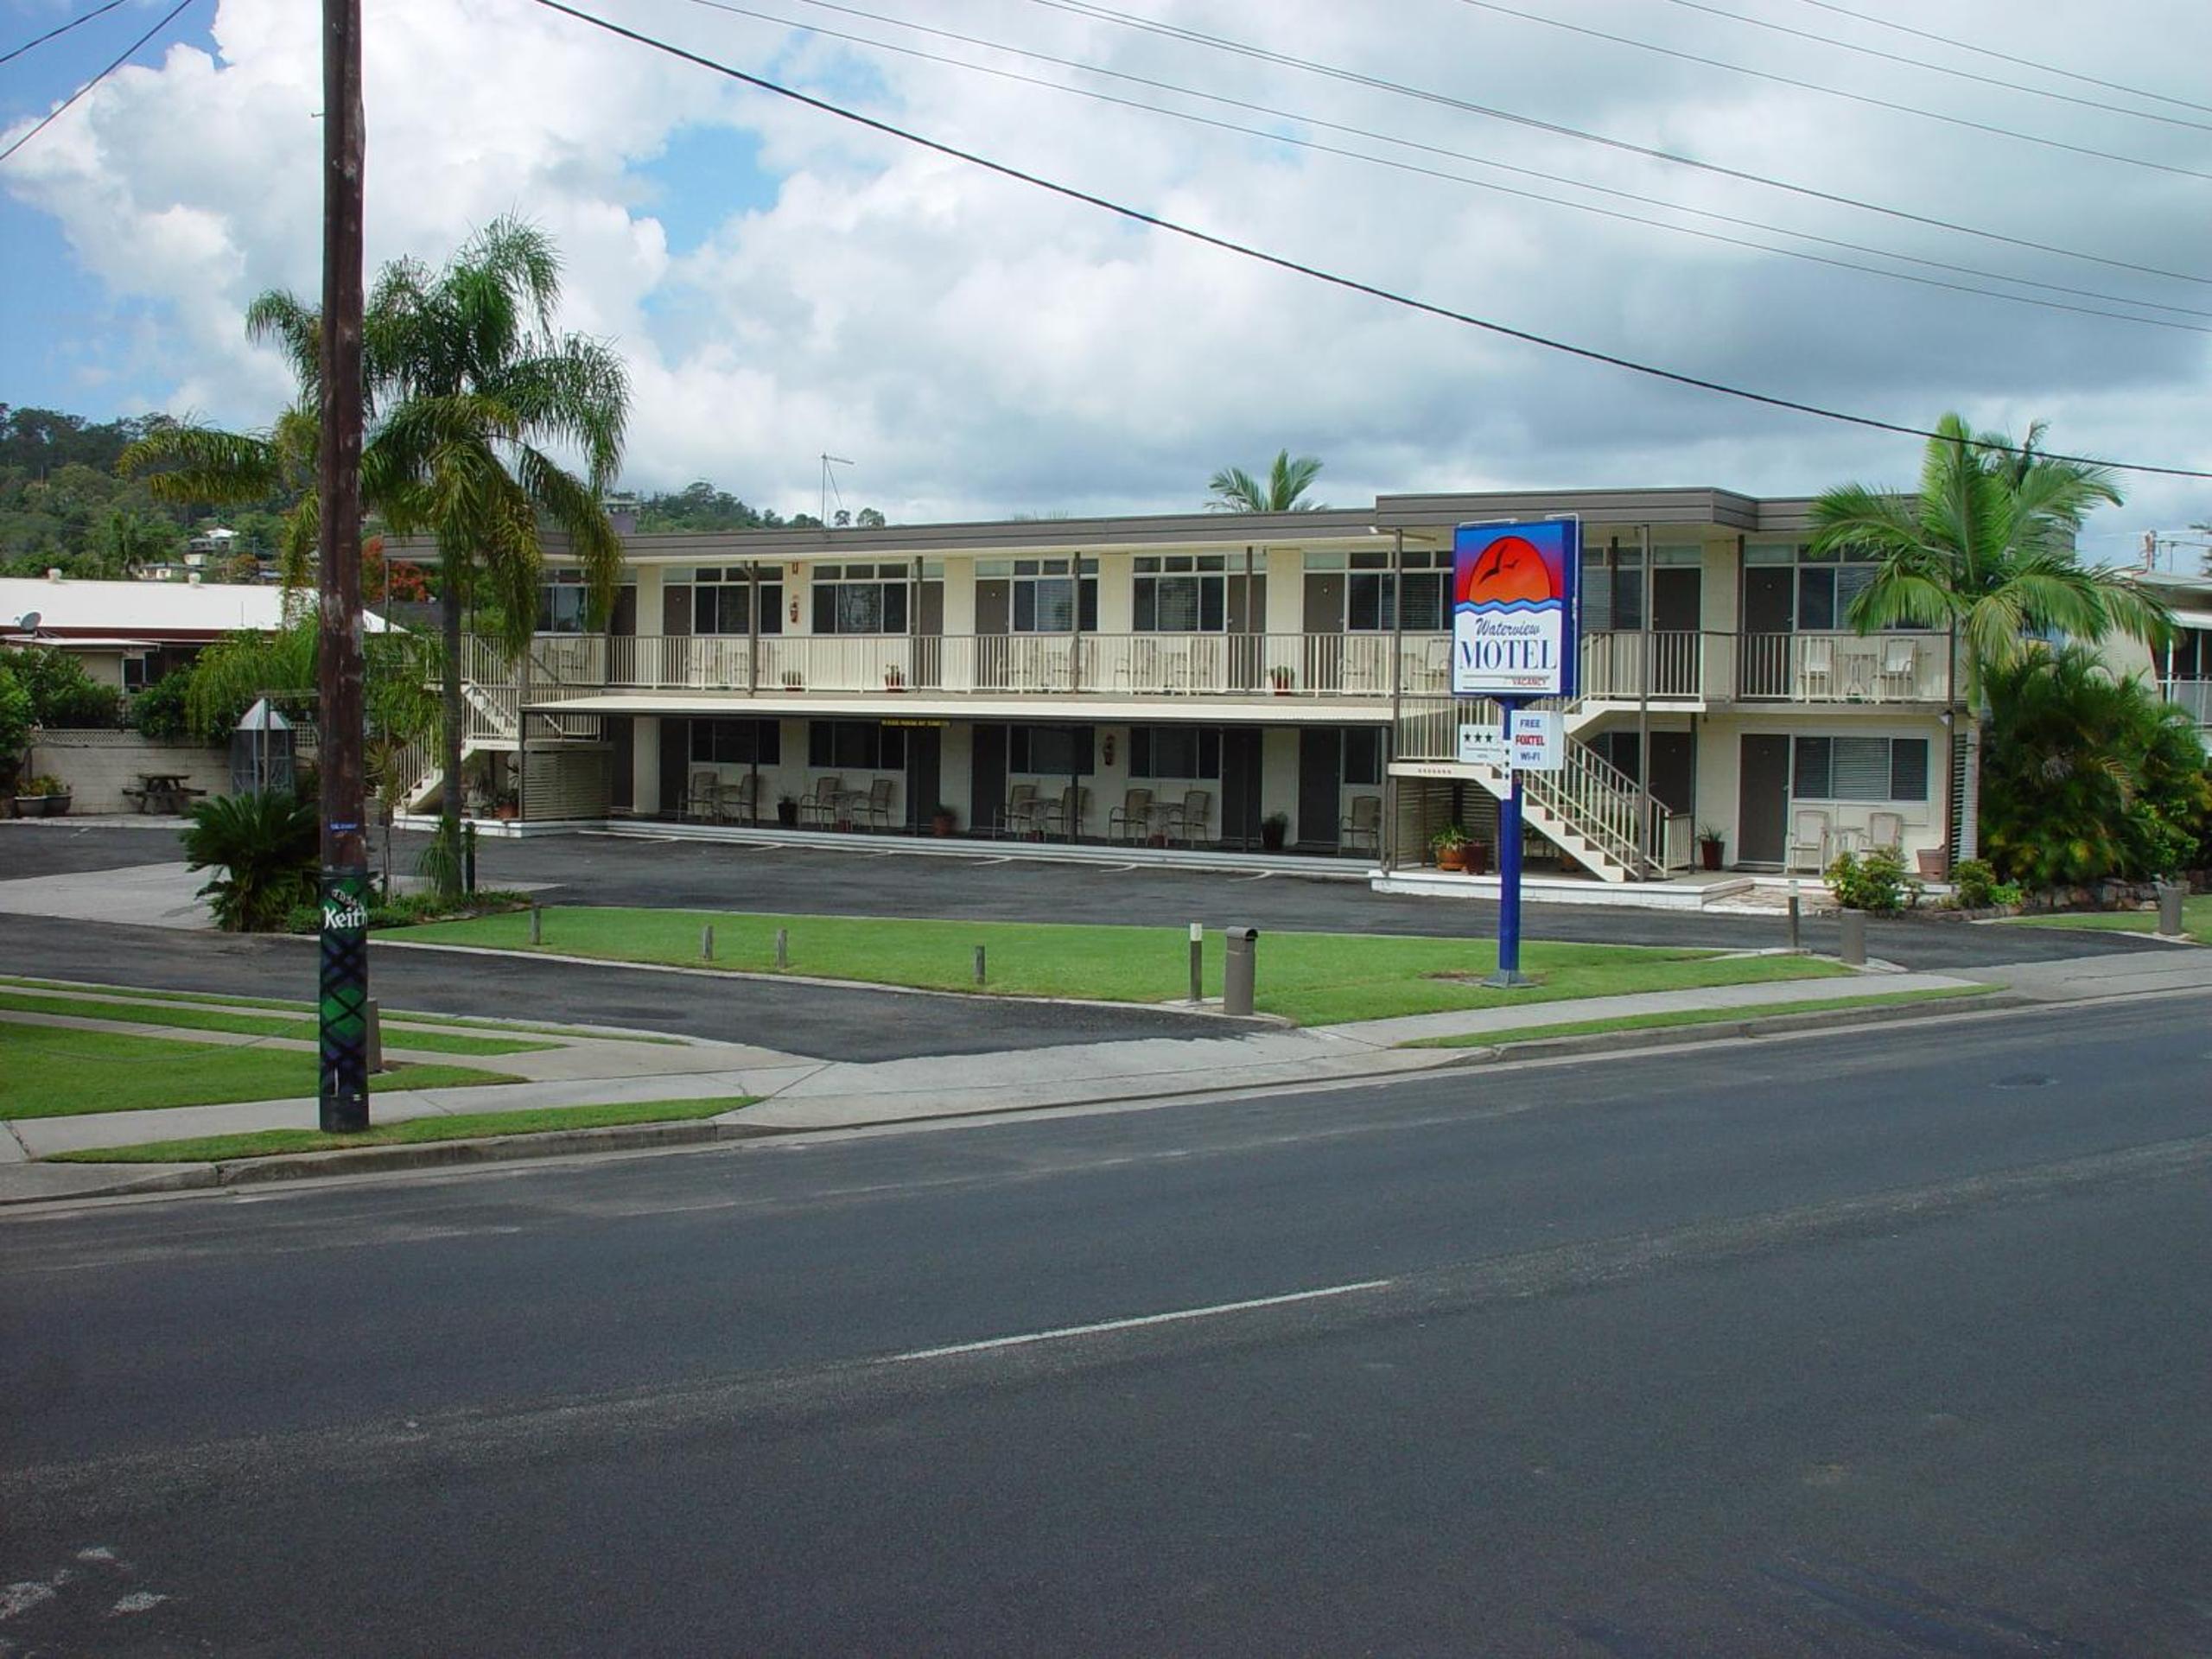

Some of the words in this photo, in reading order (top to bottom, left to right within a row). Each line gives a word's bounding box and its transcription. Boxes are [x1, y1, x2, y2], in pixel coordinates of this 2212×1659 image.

[1475, 617, 1541, 636] Waterview
[1459, 639, 1557, 670] MOTEL
[1520, 719, 1541, 728] FREE
[1516, 734, 1545, 747] FOXTEL
